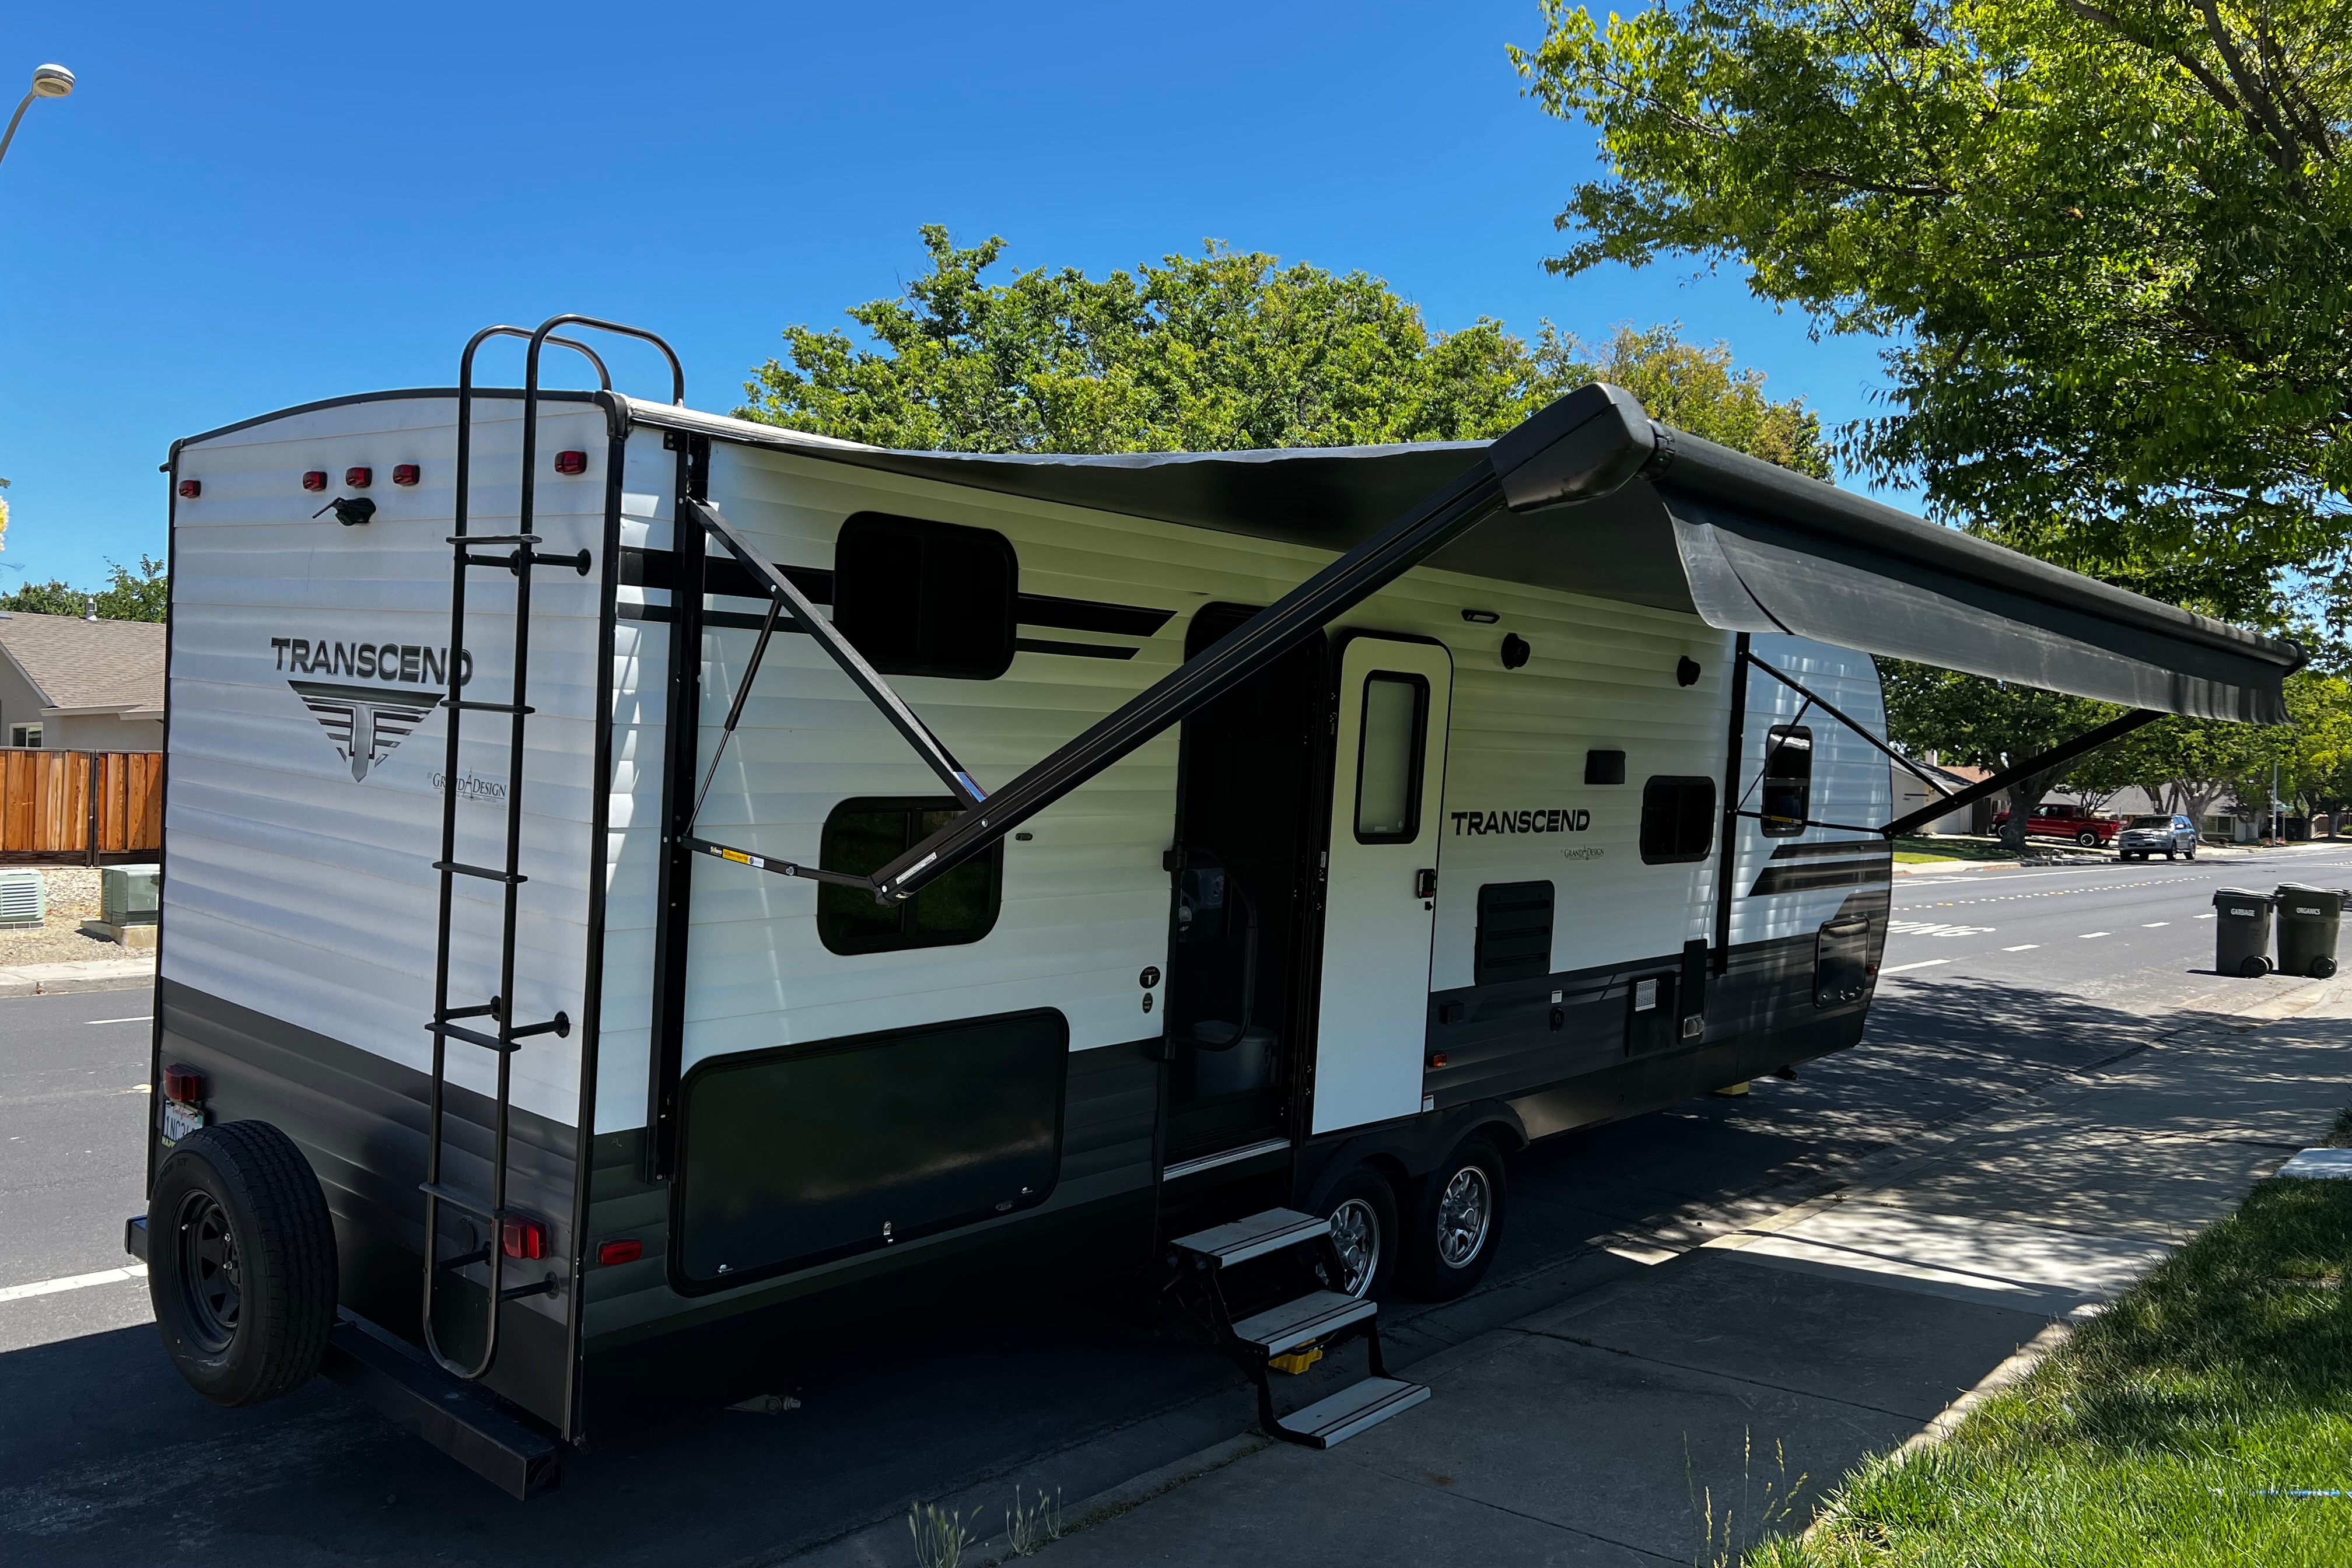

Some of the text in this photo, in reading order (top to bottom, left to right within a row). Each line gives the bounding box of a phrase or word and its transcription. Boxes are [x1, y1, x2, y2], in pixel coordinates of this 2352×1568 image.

[271, 636, 473, 687] TRANSCEND
[433, 773, 465, 790] GRD
[473, 779, 507, 797] DESIGN
[1451, 809, 1590, 836] TRANSCEND
[1564, 849, 1583, 858] GRAND
[1587, 848, 1604, 856] DESIGN
[2231, 908, 2255, 916] GARBAGE
[2296, 907, 2321, 915] ORGANICS
